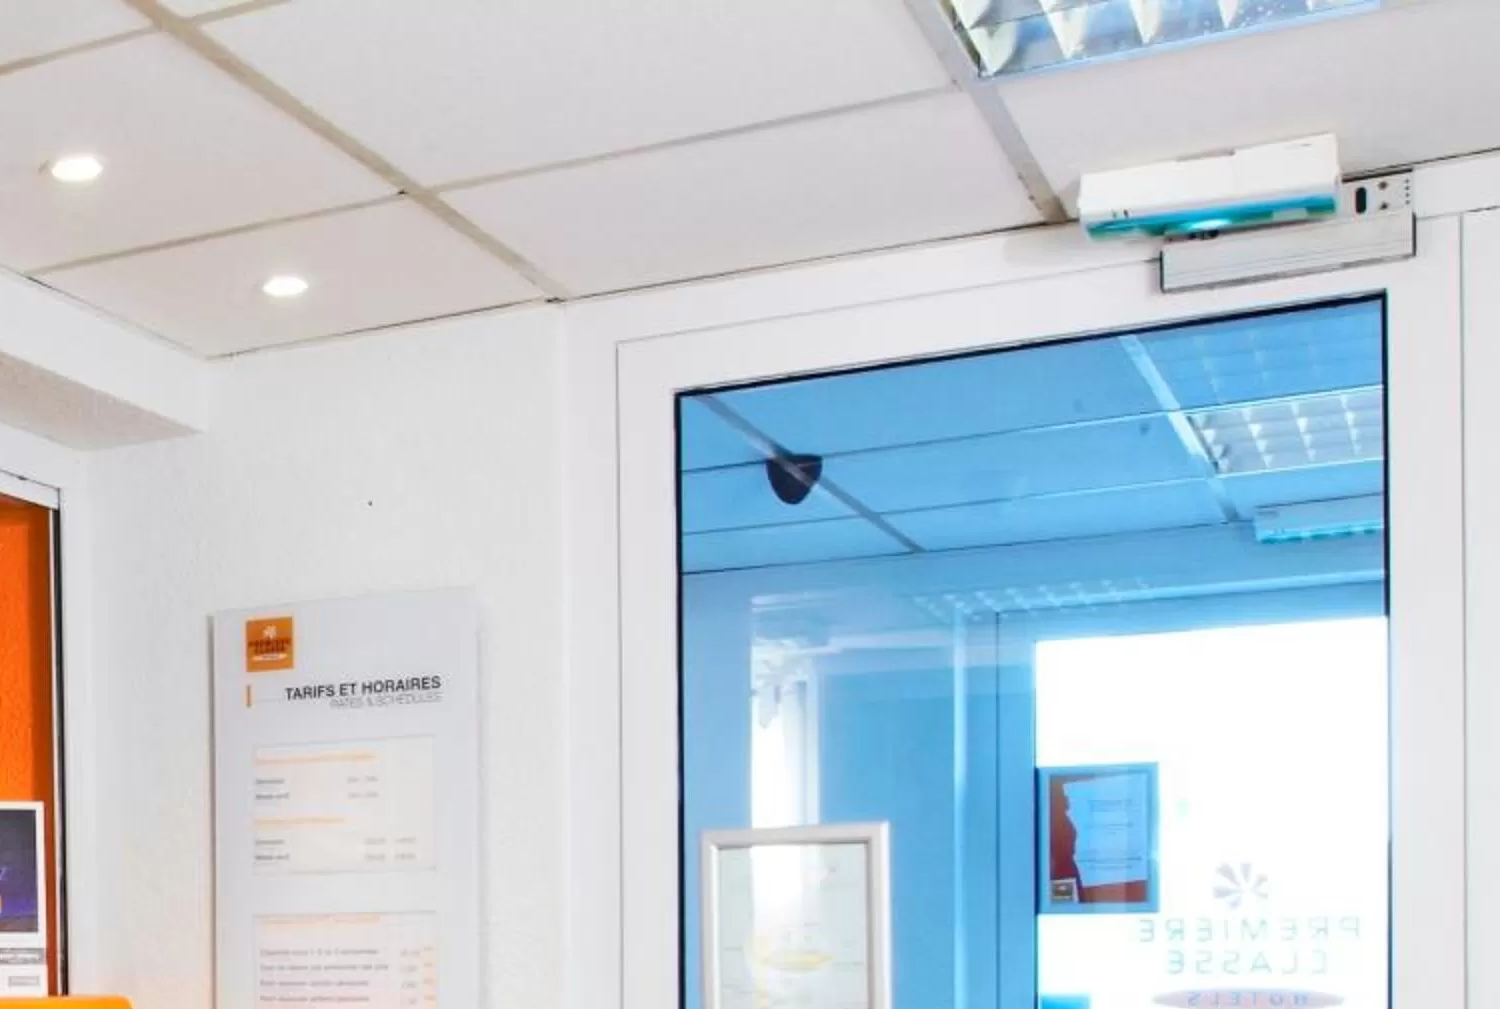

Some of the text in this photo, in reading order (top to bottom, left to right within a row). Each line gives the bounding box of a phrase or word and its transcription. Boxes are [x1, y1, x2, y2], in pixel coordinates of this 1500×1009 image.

[285, 675, 442, 701] TARIFS ET HORAIRES
